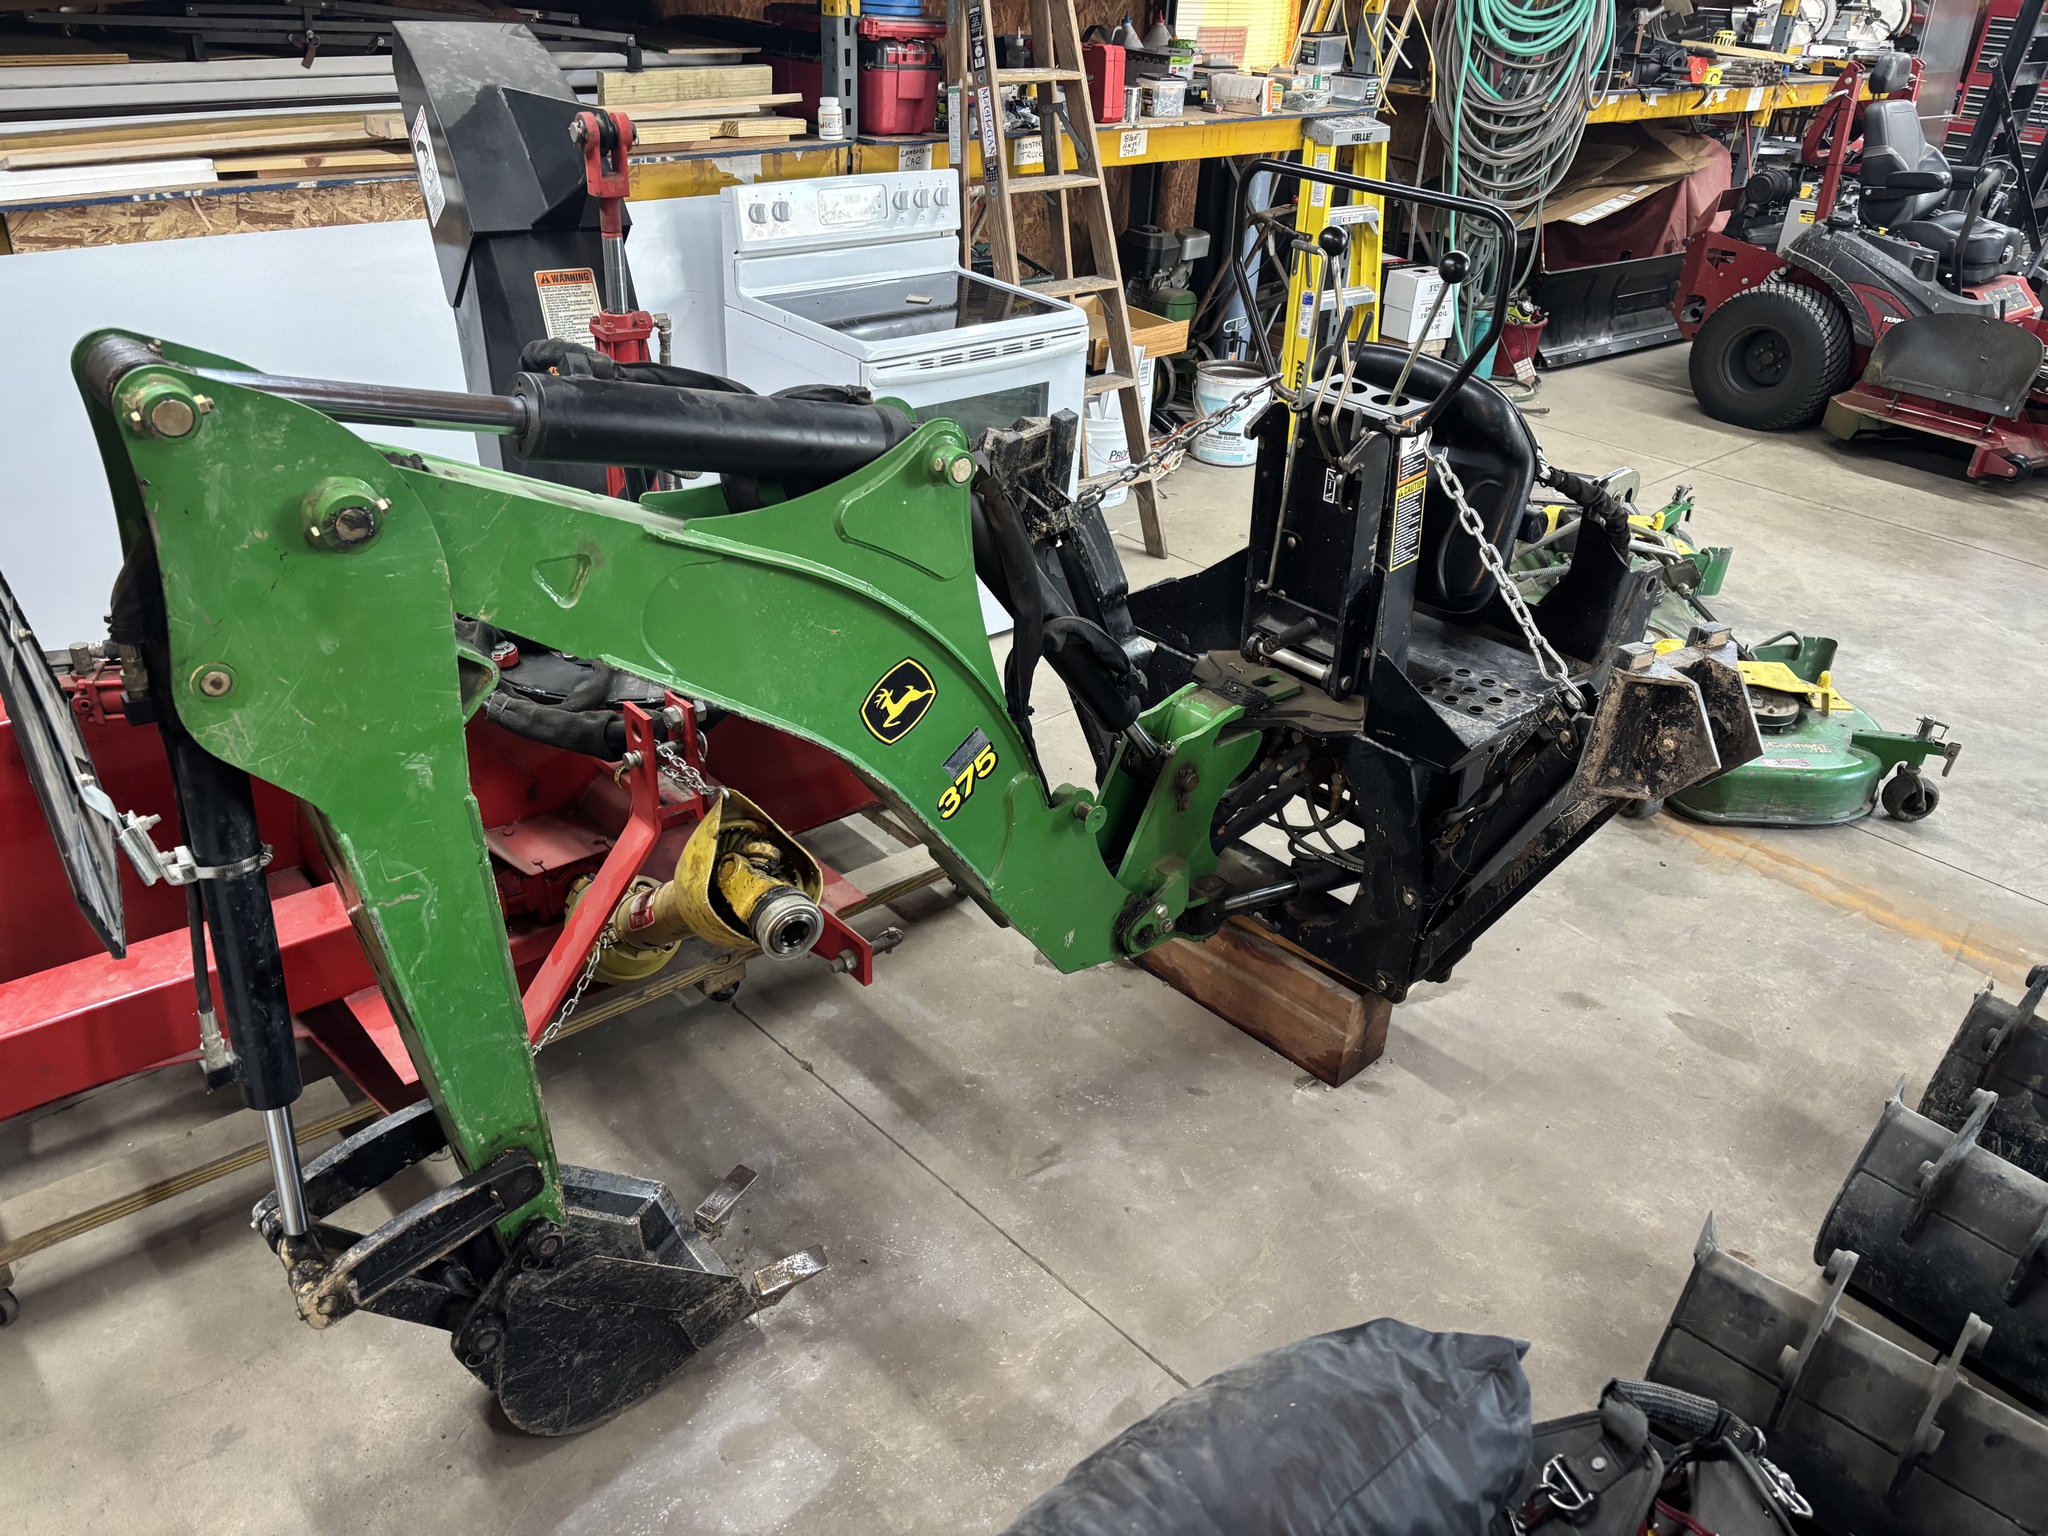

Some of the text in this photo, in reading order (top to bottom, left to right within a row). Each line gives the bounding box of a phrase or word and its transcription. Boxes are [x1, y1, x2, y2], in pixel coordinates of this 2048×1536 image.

[905, 156, 922, 167] CAR
[550, 272, 590, 283] WARNING
[1883, 315, 1906, 325] FERR
[1404, 478, 1425, 496] CAUTION
[937, 742, 998, 820] 375
